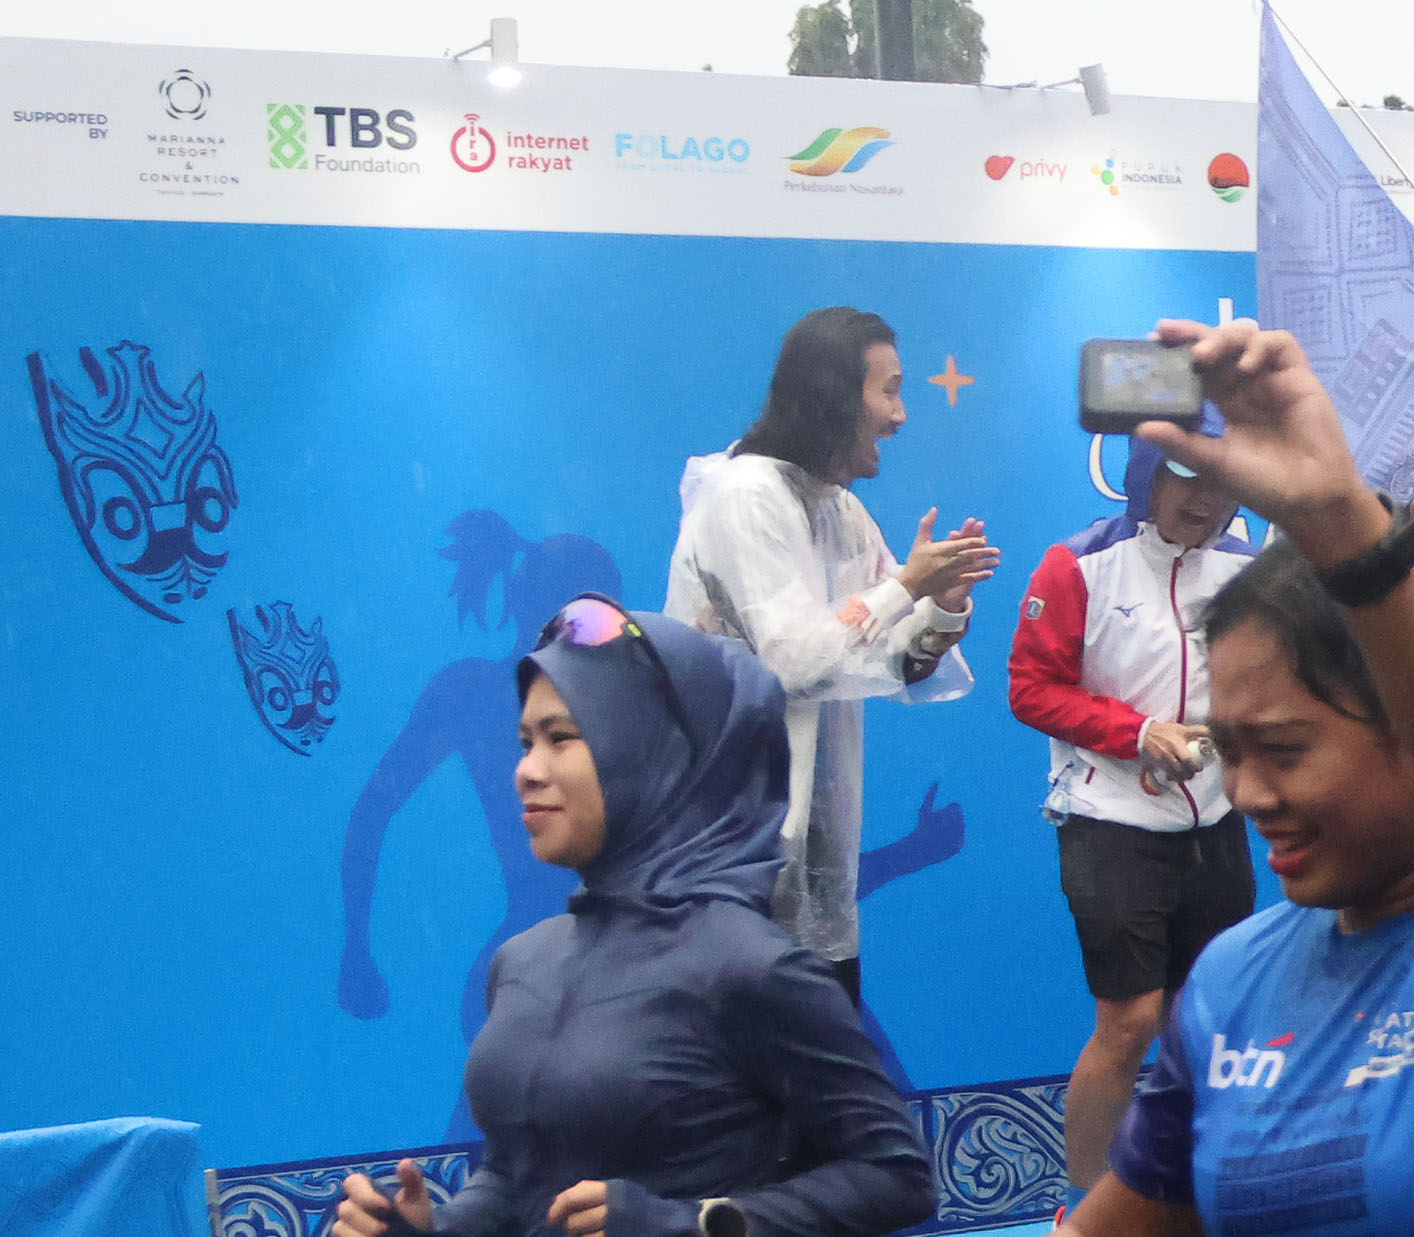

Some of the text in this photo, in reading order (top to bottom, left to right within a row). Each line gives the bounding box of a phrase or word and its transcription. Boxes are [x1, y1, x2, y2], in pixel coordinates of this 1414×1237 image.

[13, 110, 108, 125] SUPPORTED
[89, 127, 109, 139] BY
[314, 106, 418, 151] TBS
[147, 134, 226, 145] MARIANNA
[507, 131, 590, 151] internet
[614, 133, 750, 163] FOLAGO
[157, 147, 218, 158] RESORT
[185, 161, 193, 170] &
[314, 154, 421, 175] Foundation
[508, 154, 573, 173] rakyat
[1020, 158, 1068, 181] privy
[139, 172, 240, 185] CONVENTION
[1121, 173, 1183, 185] INDONESIA
[1208, 1033, 1287, 1088] btn
